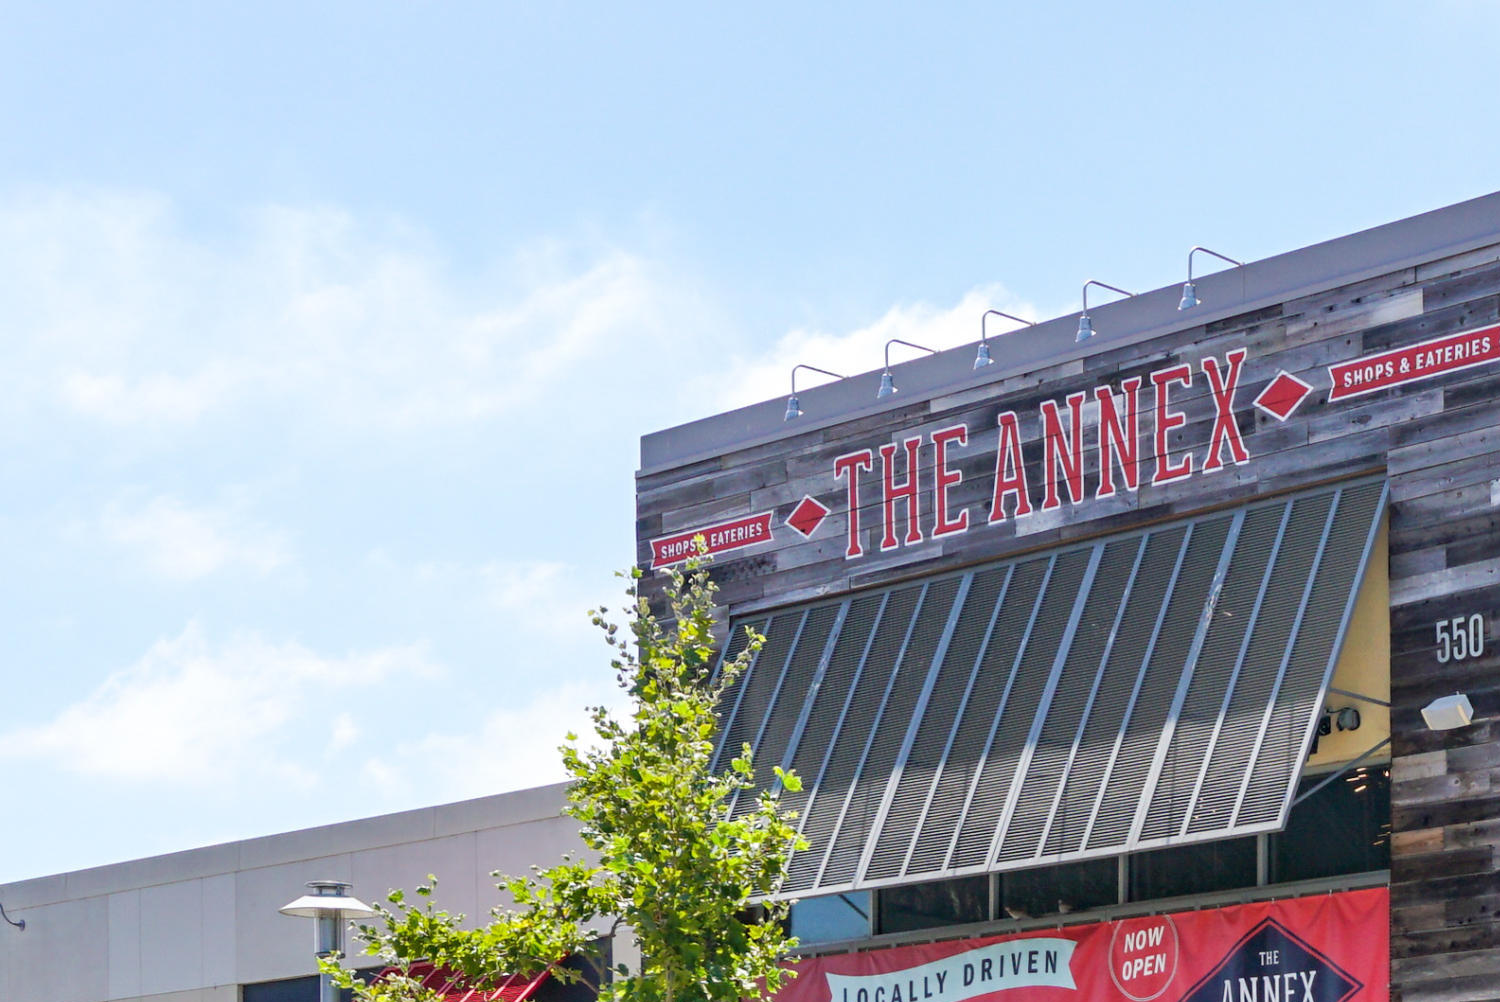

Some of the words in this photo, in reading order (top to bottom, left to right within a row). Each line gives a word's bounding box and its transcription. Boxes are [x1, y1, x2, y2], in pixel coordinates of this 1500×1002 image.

[1343, 361, 1394, 388] SHOPS
[1399, 357, 1410, 374] &
[1415, 336, 1491, 370] EATERIES
[834, 424, 969, 560] THE
[987, 347, 1250, 526] ANNEX
[661, 540, 697, 559] SHOPS
[710, 522, 763, 547] EATERIES
[1436, 613, 1484, 664] 550
[1123, 925, 1165, 953] NOW
[963, 949, 1059, 984] DRIVEN
[1122, 953, 1167, 981] OPEN
[1259, 950, 1279, 966] THE
